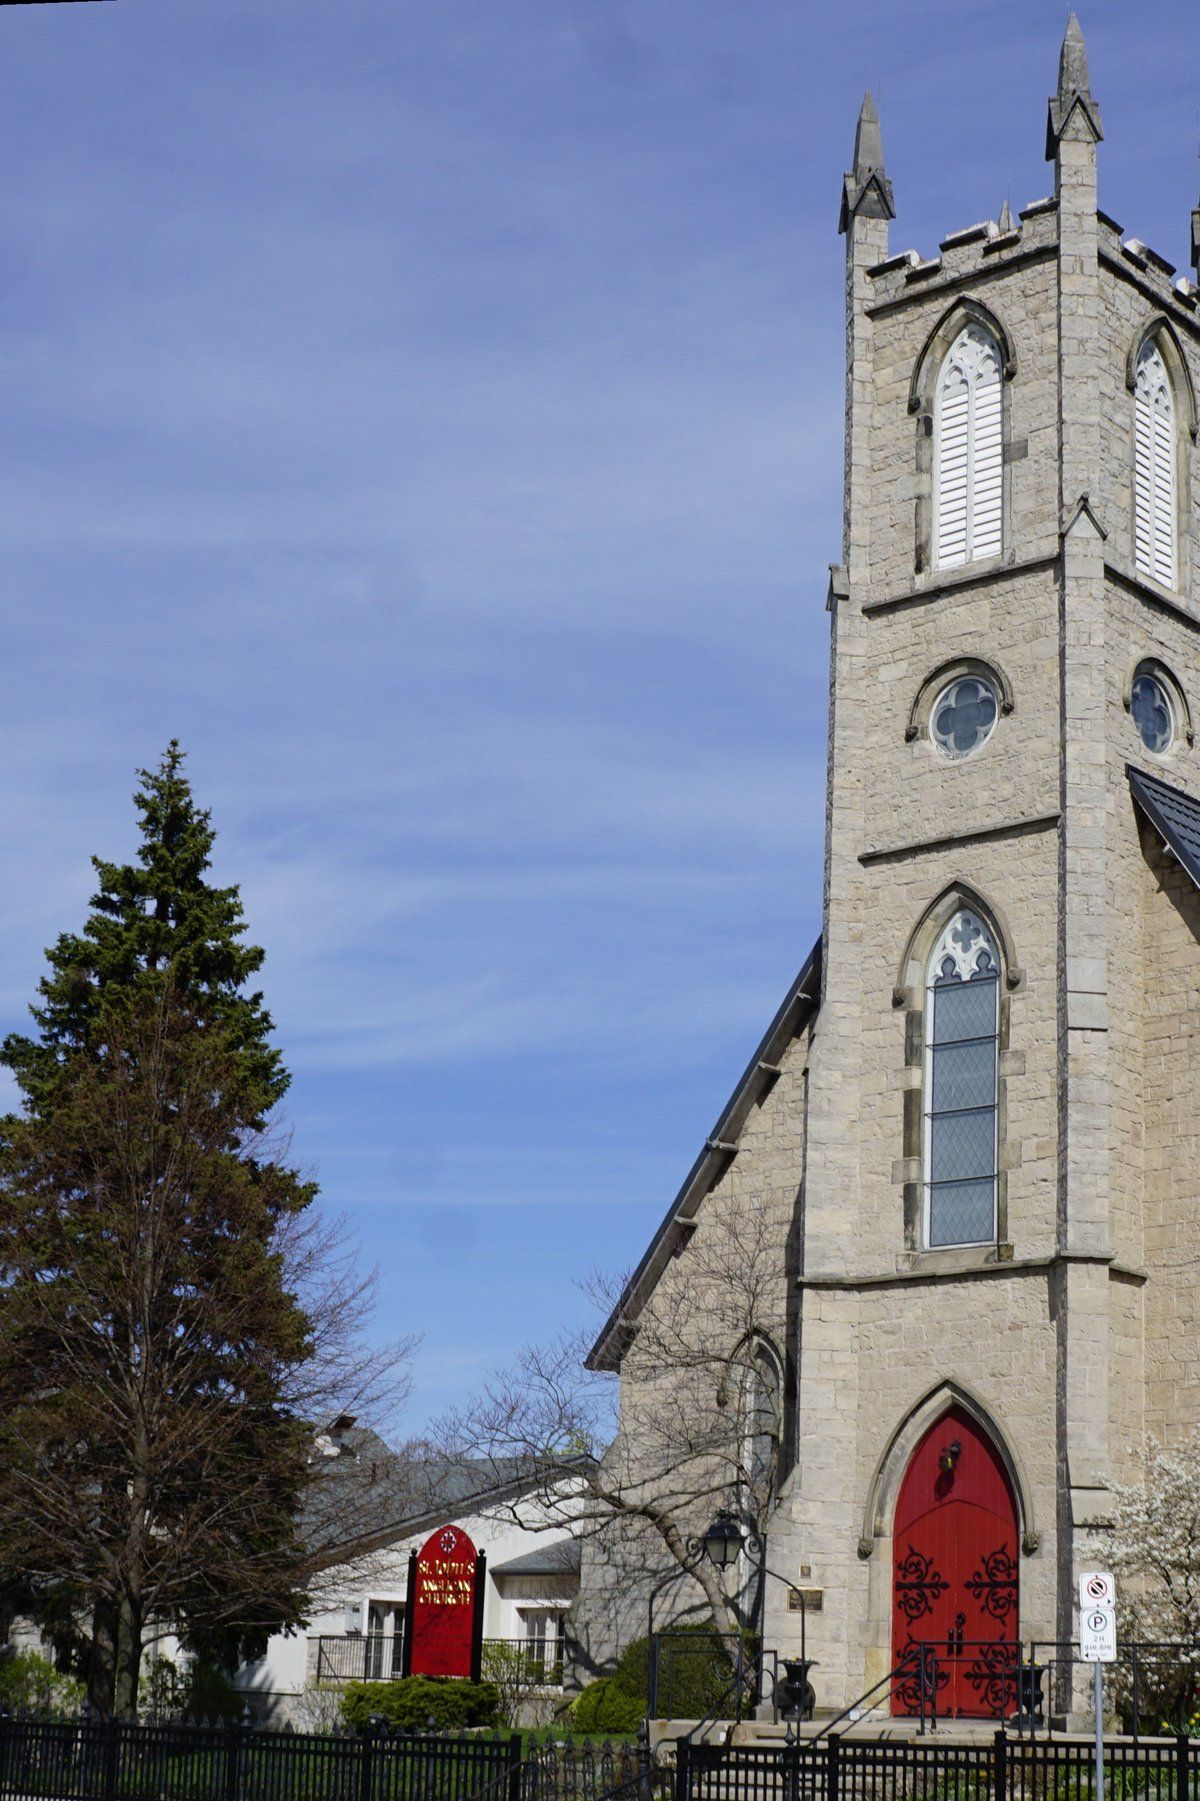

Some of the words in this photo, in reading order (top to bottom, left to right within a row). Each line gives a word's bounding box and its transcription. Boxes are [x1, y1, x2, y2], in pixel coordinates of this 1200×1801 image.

[421, 1579, 471, 1592] ANGLICAN
[419, 1592, 470, 1605] CHURCH
[1094, 1616, 1103, 1628] P
